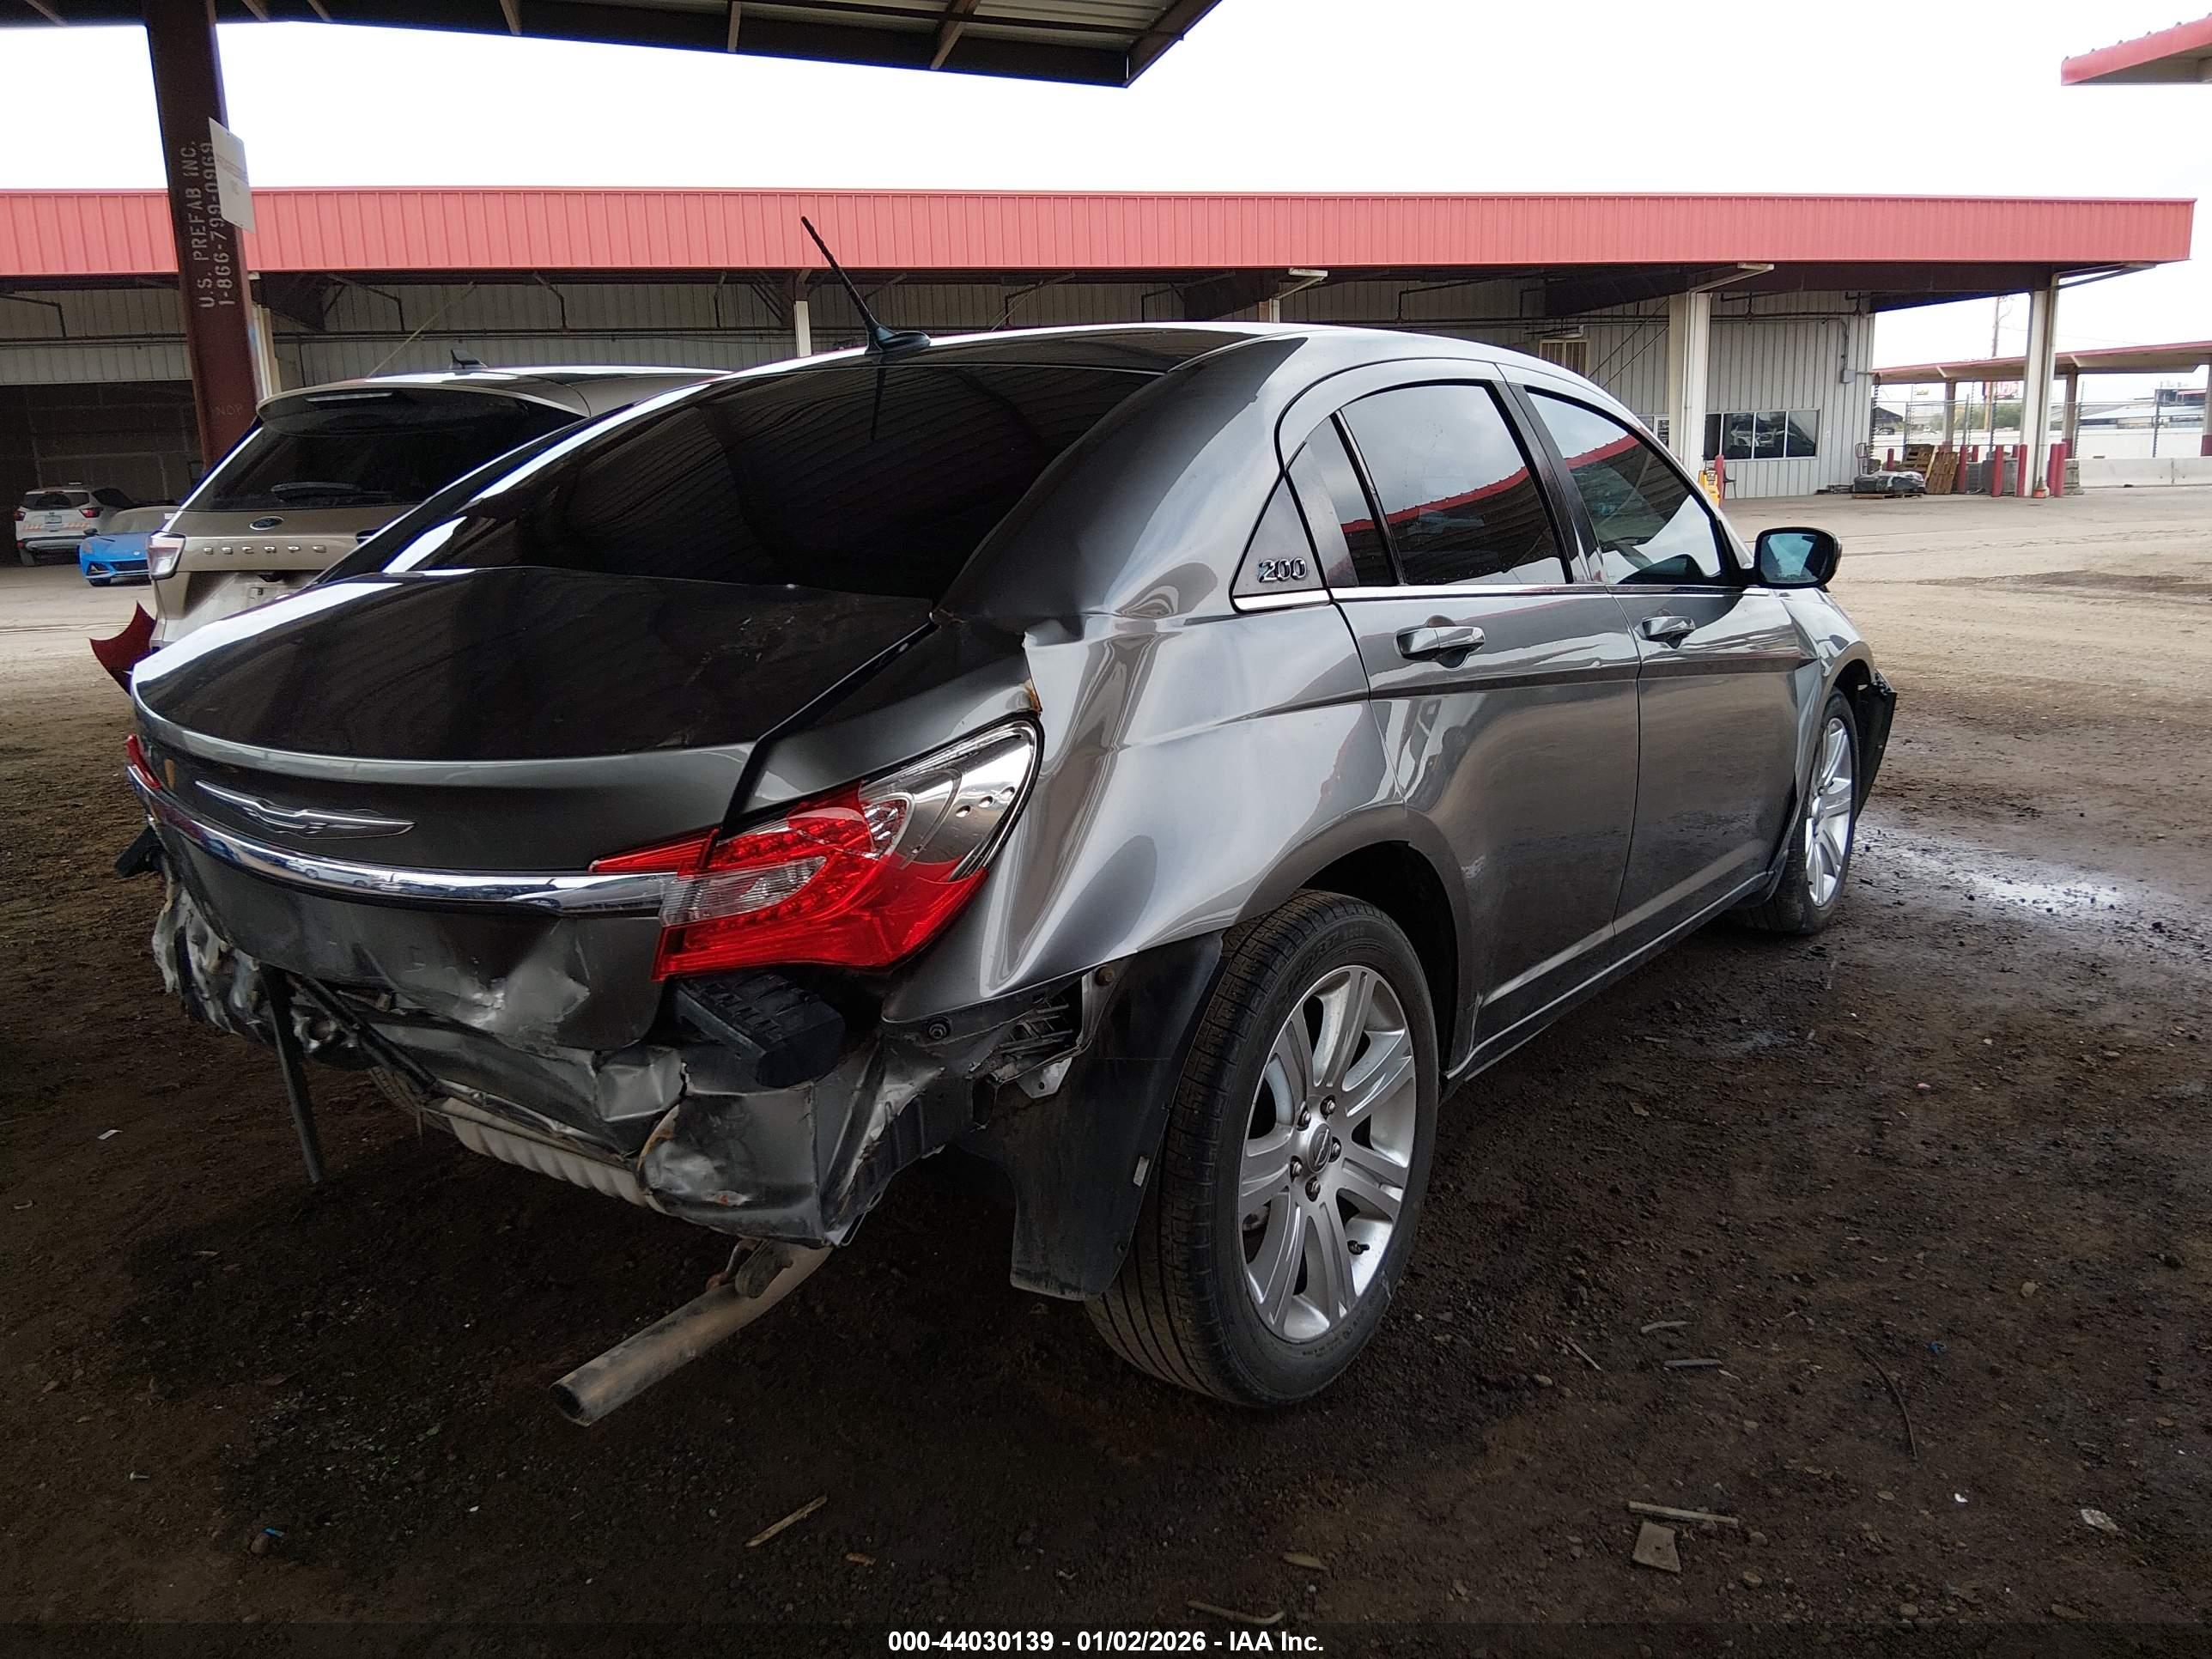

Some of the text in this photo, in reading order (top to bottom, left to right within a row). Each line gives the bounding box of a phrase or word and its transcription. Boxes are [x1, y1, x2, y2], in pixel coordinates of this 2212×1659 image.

[179, 140, 216, 308] U.S. PREFAB INC.
[203, 545, 328, 556] ESCAPE
[1257, 556, 1307, 583] 200
